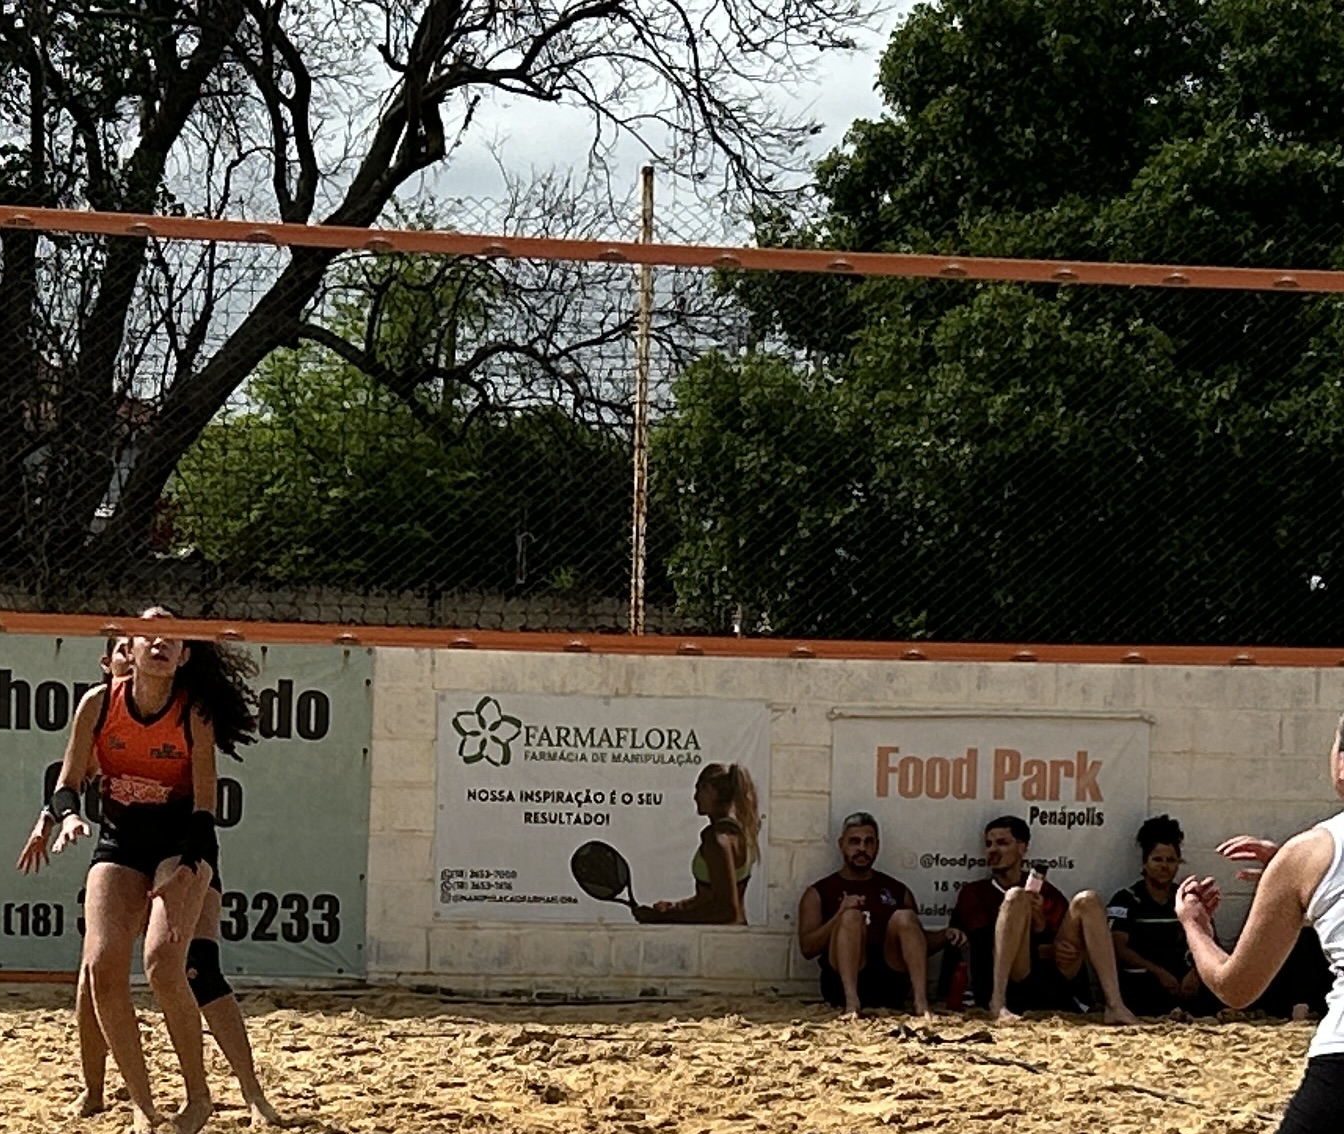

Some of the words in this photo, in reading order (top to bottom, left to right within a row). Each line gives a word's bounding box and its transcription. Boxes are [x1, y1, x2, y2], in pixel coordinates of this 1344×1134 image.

[523, 725, 701, 750] FARMAFLORA
[523, 749, 588, 763] FARMÁCIA
[591, 752, 607, 763] DE
[611, 752, 703, 767] MANIPULAÇÃO
[875, 746, 978, 800] Food
[992, 748, 1105, 802] Park
[466, 788, 515, 802] NOSSA
[519, 788, 605, 807] INSPIRAÇÃO
[609, 788, 617, 804] É
[620, 790, 633, 806] O
[637, 792, 663, 806] SEU
[523, 811, 611, 826] RESULTADO!
[1029, 805, 1105, 830] Penápolis
[2, 902, 64, 938] (18)
